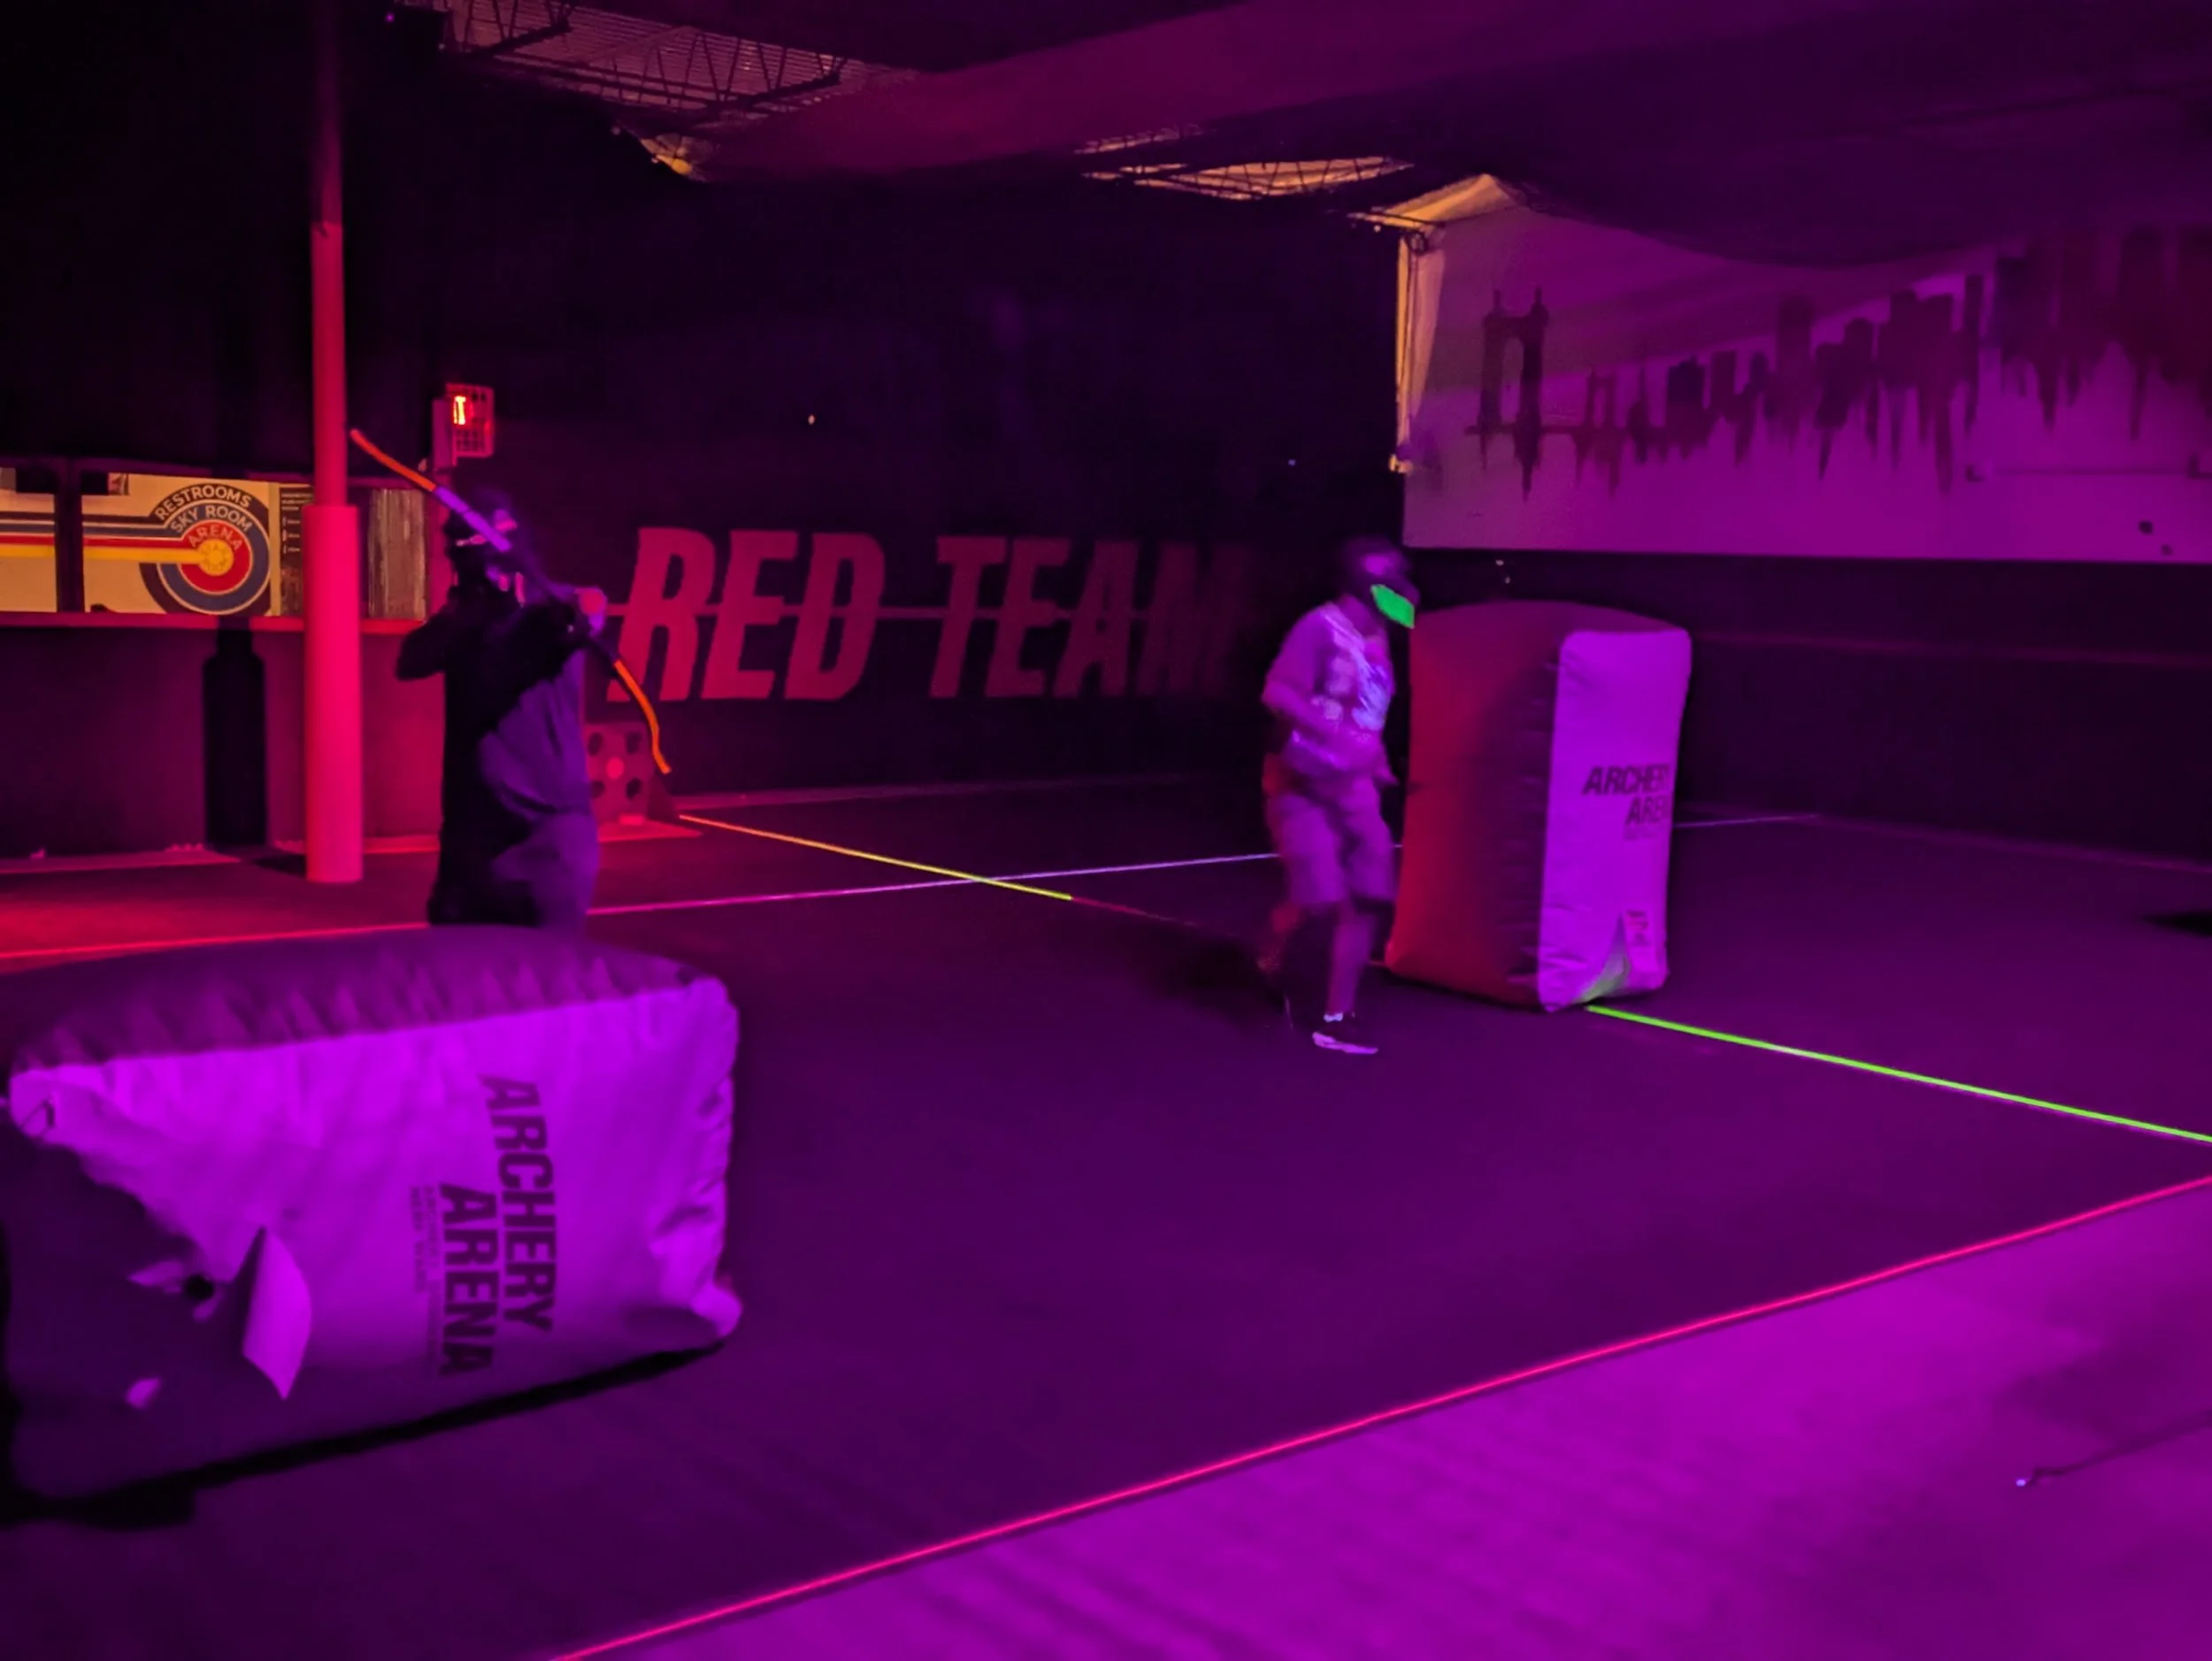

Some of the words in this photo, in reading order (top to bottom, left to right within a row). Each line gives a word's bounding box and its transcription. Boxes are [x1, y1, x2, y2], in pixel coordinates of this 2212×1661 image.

[155, 484, 252, 521] RESTROOMS
[170, 507, 199, 533] SKY
[204, 504, 253, 532] ROOM
[188, 524, 242, 551] ARENA
[607, 527, 884, 701] RED
[928, 534, 1255, 698] TEAM
[477, 1072, 557, 1333] ARCHERY
[438, 1180, 499, 1377] ARENA
